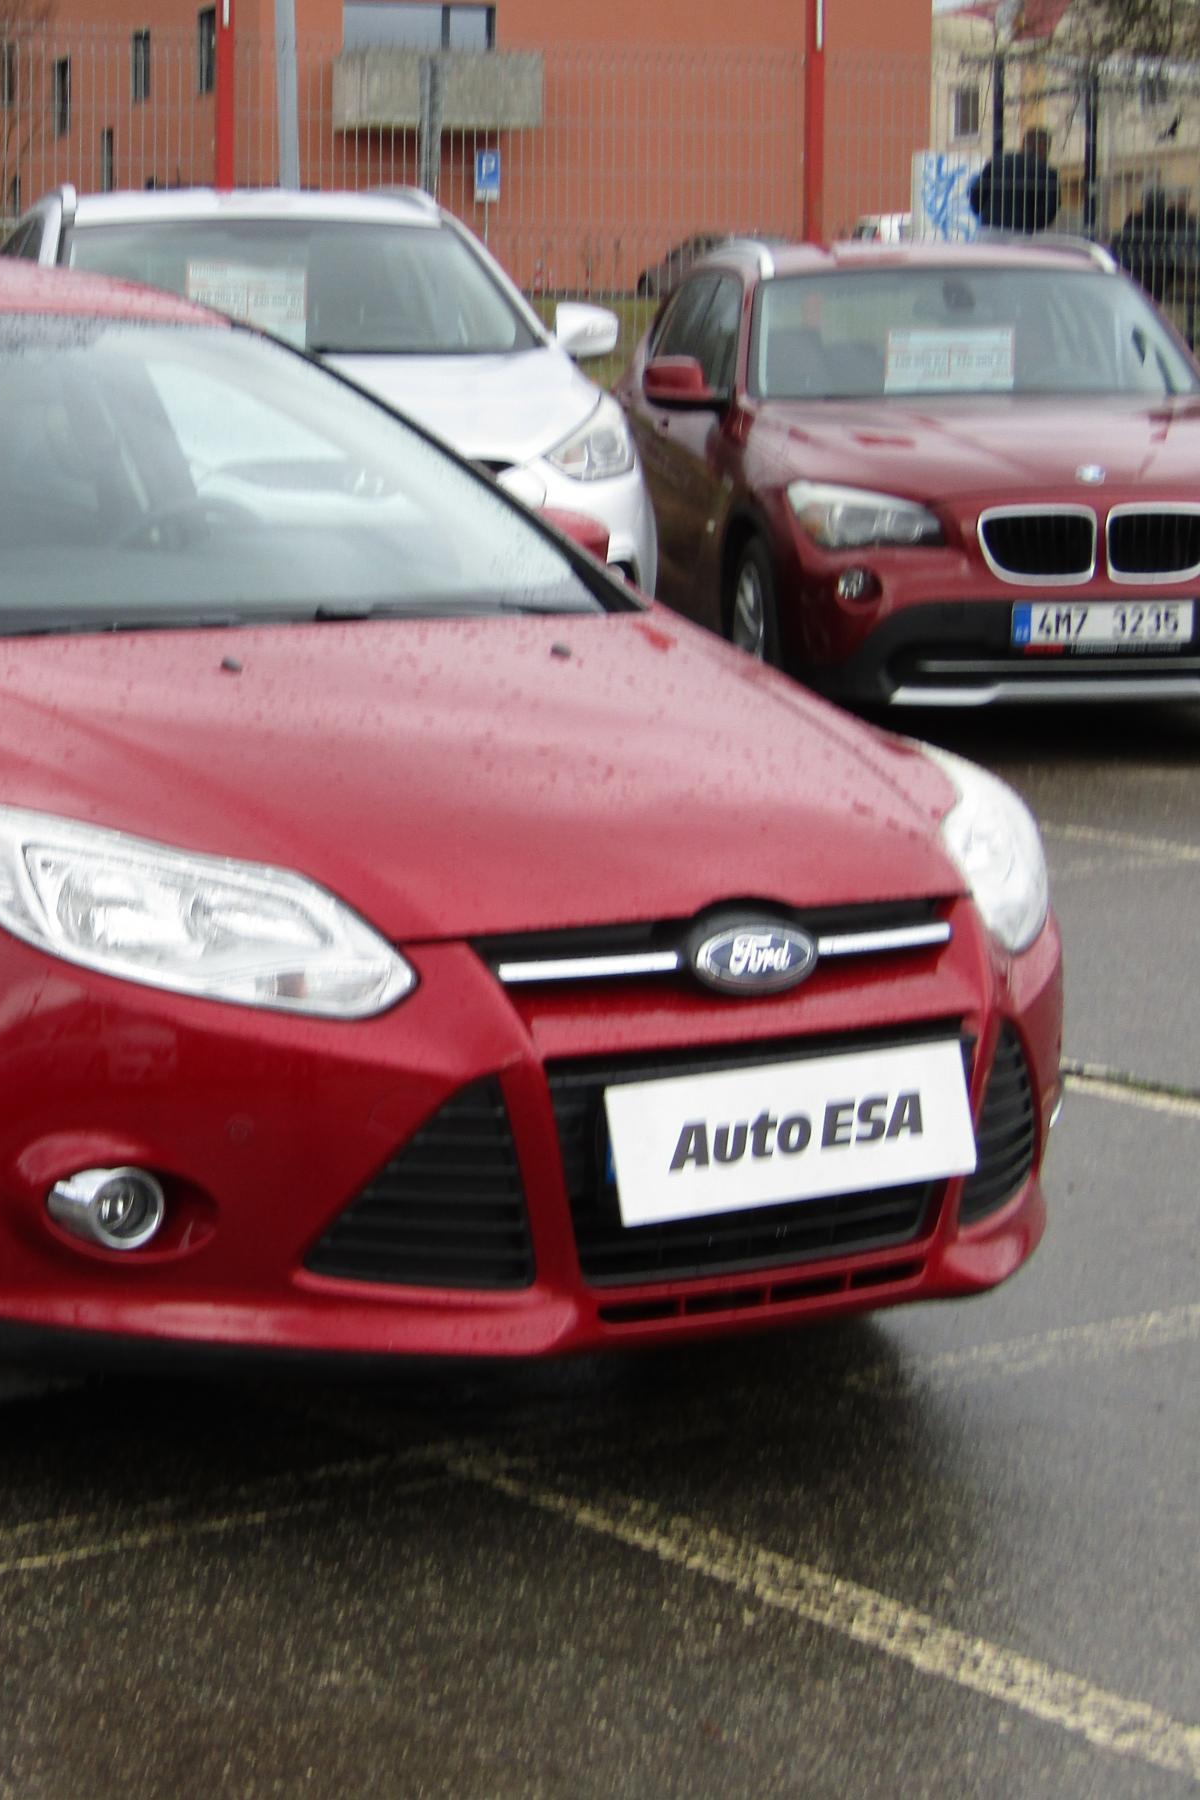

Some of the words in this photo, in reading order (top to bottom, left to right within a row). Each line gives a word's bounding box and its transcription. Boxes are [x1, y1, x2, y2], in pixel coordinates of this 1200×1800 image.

[482, 153, 496, 183] P
[1038, 603, 1088, 638] 4M7
[1113, 602, 1179, 638] 3235
[729, 933, 791, 976] Ford
[668, 1109, 812, 1173] Auto
[820, 1088, 923, 1149] ESA
